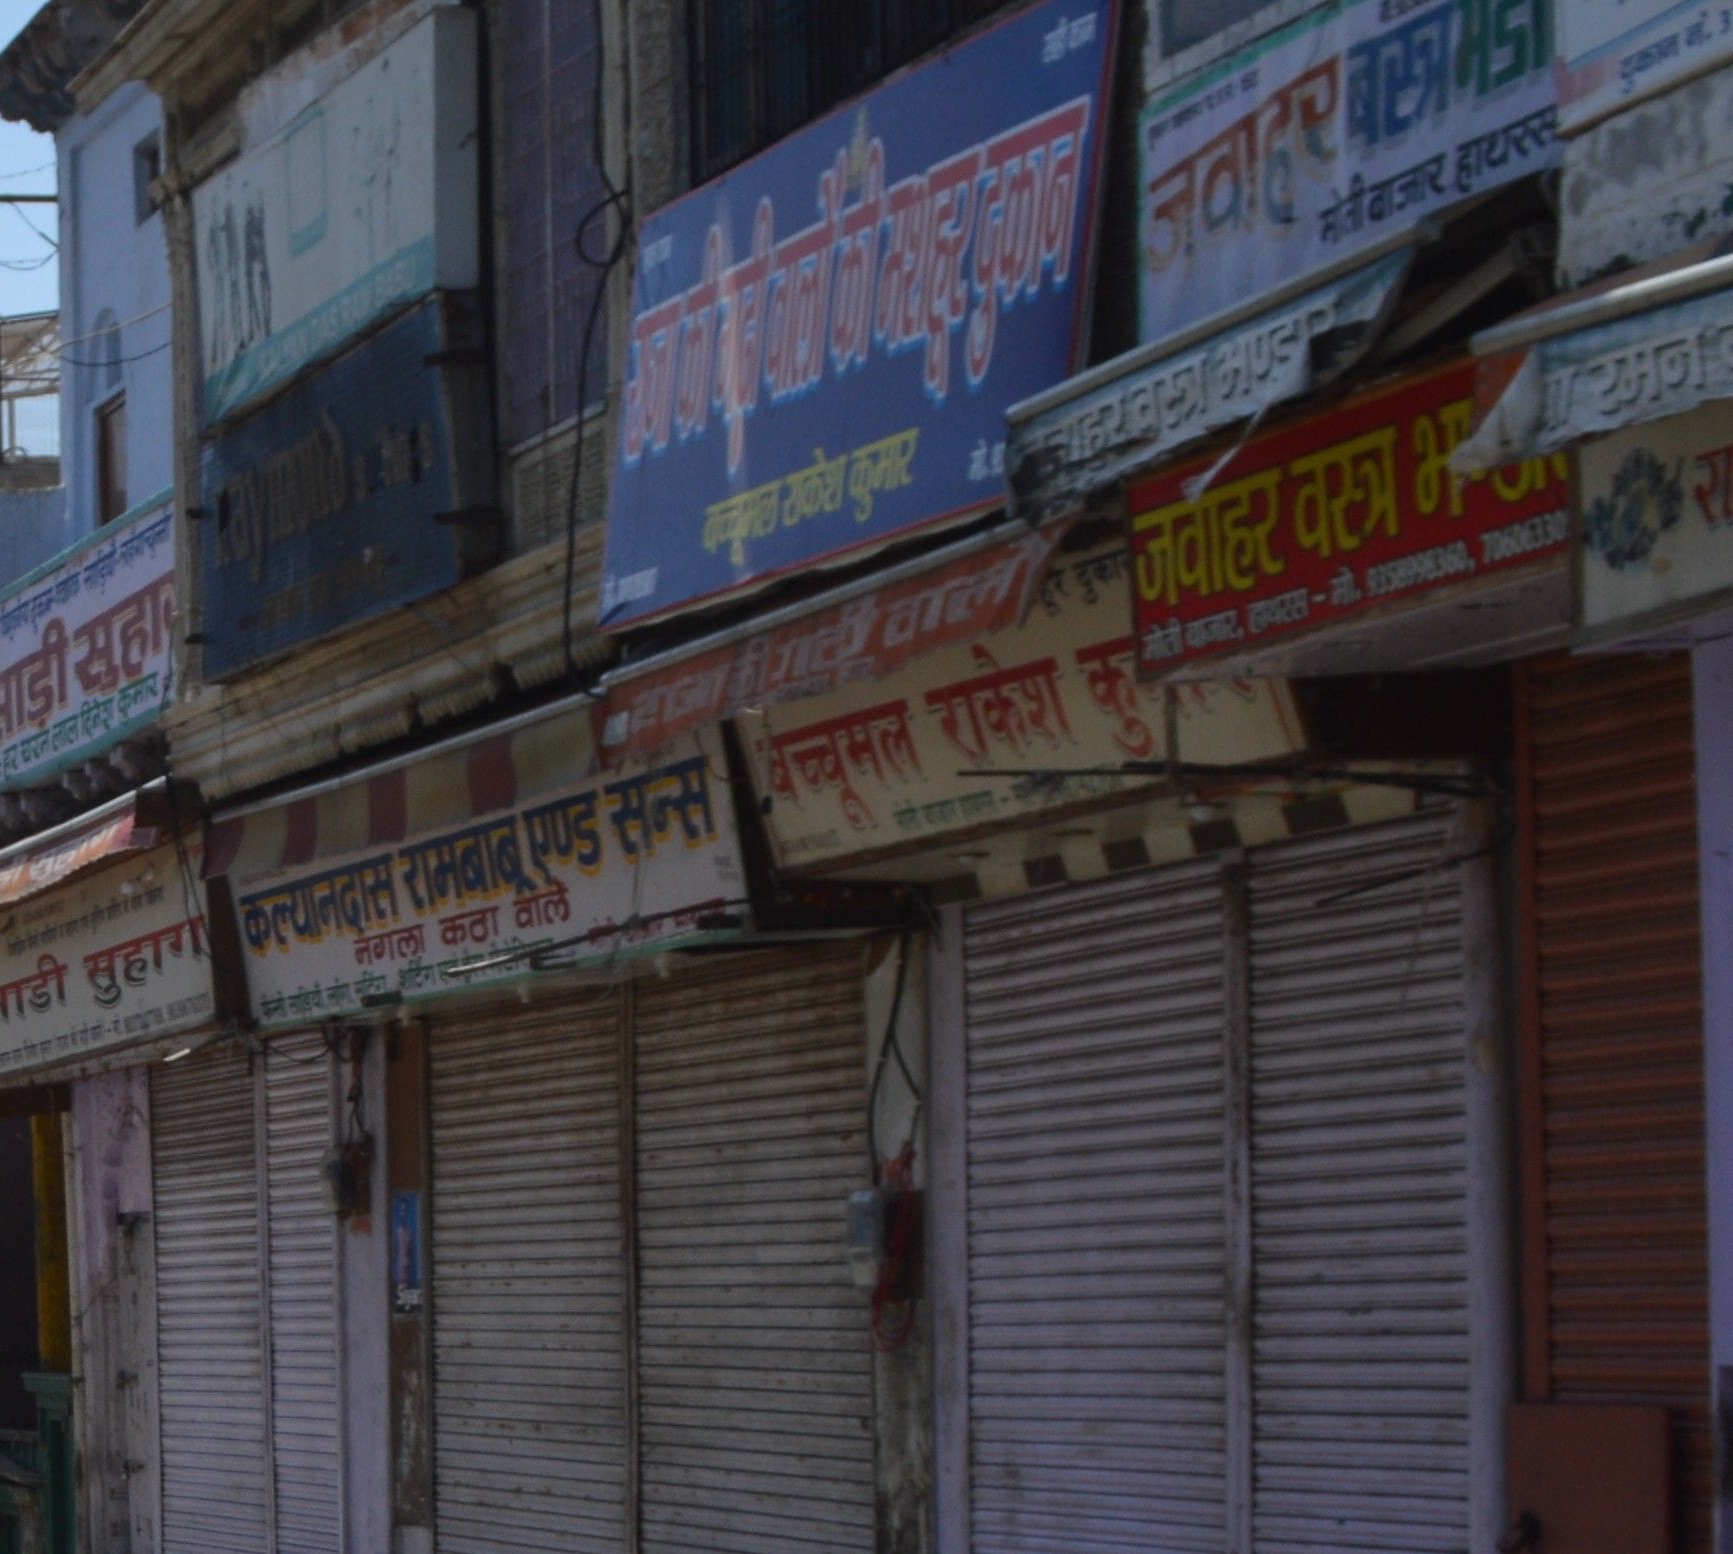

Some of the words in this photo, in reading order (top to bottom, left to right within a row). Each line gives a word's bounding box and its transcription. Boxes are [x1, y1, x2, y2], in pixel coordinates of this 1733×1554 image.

[1131, 464, 1285, 608] जवाहर
[1288, 422, 1401, 560] वस्त्र
[925, 642, 1081, 762] राकेश
[238, 852, 405, 958] कल्यानदास
[395, 814, 531, 916] रामबाबू
[603, 754, 719, 860] सन्स
